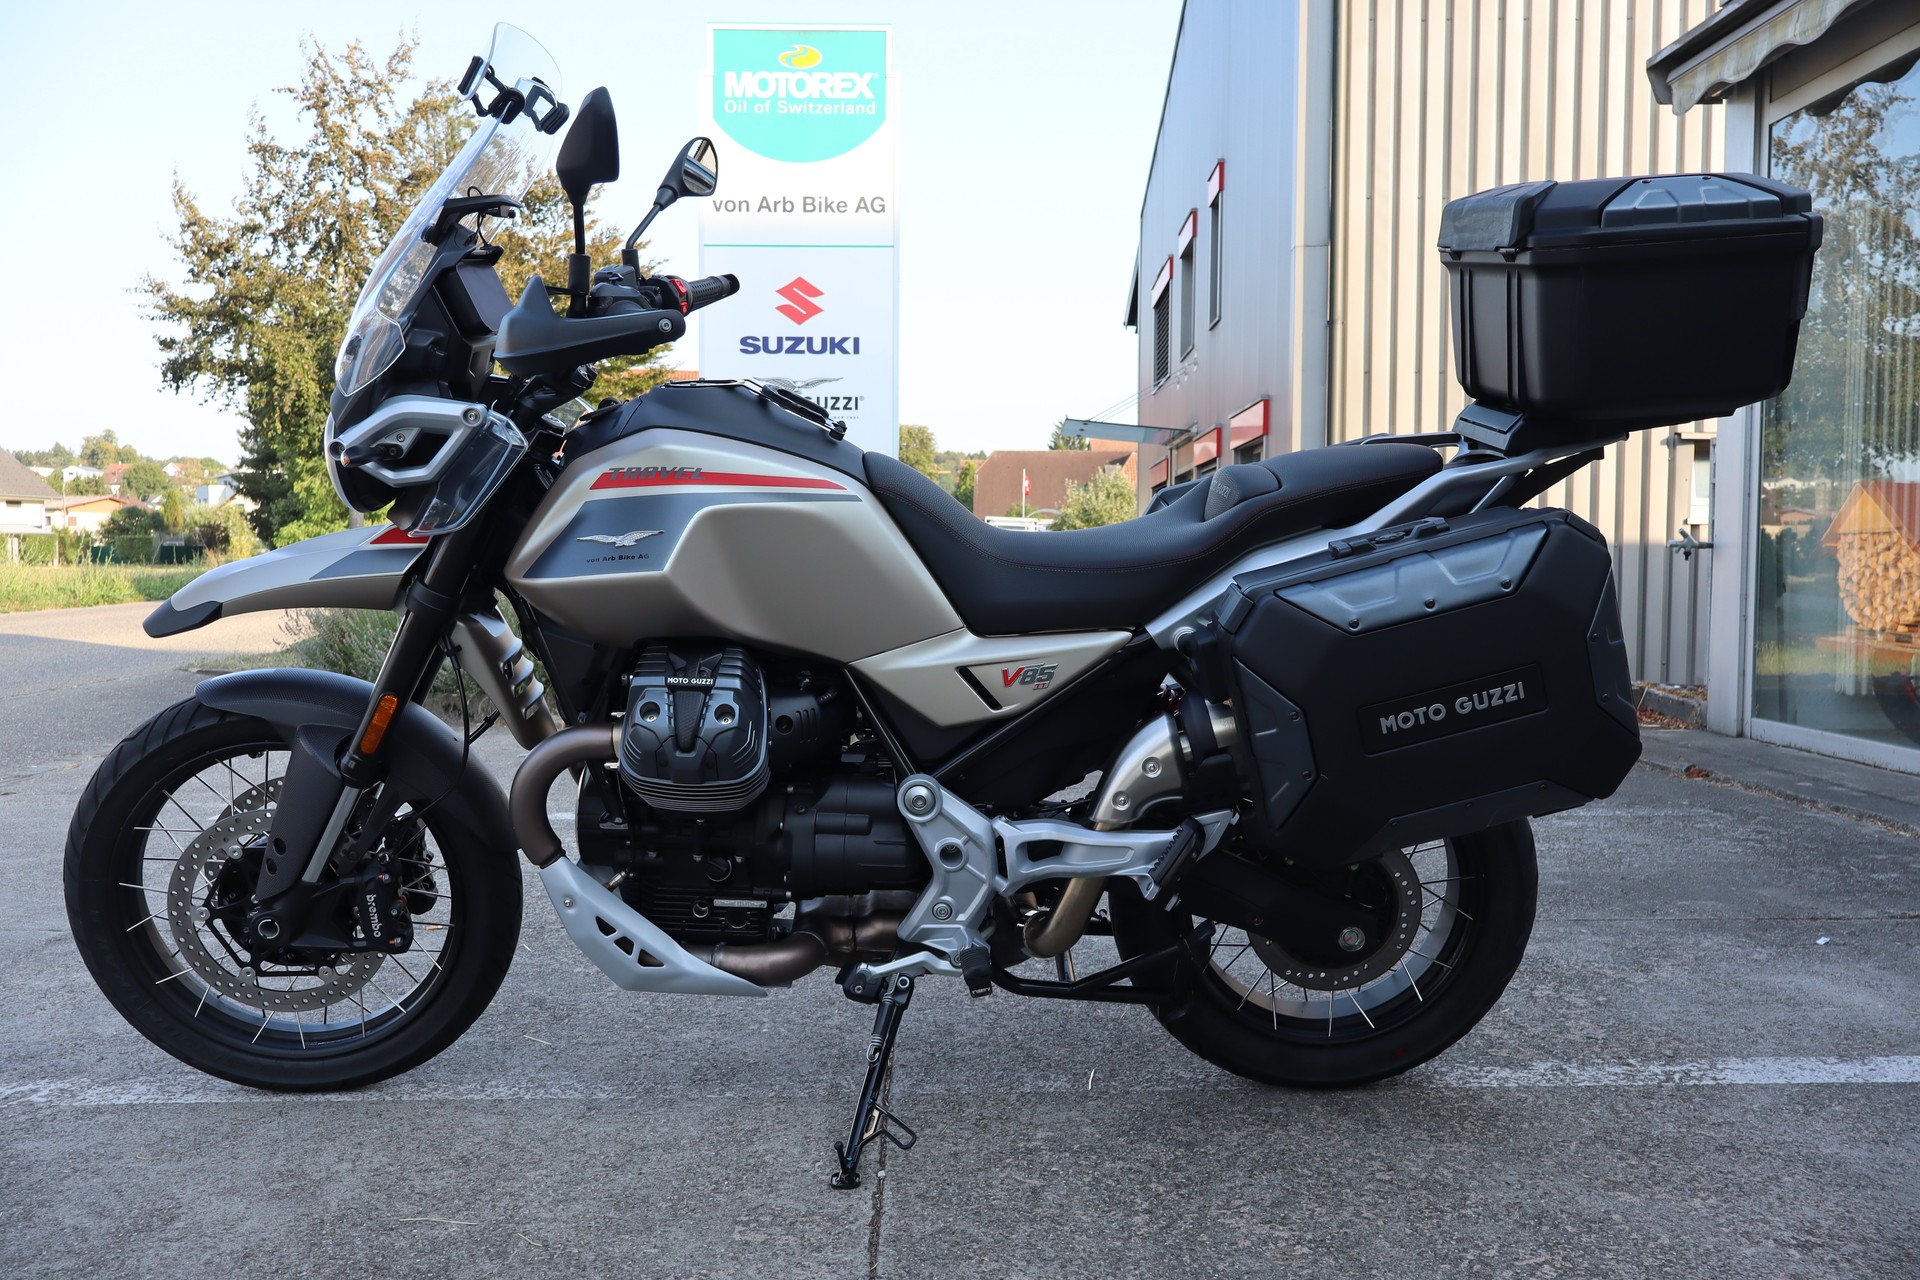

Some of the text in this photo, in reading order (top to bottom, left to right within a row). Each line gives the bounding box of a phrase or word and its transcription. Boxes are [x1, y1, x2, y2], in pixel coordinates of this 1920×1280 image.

[724, 71, 875, 98] MOTOREX
[724, 100, 876, 115] Oil of Switzerland
[712, 196, 886, 213] von Arb Bike AG
[739, 336, 860, 355] SUZUKI
[804, 396, 859, 411] UZZI
[608, 466, 706, 481] TRAVEL
[602, 554, 616, 562] Arb
[618, 553, 636, 561] Bike
[1001, 662, 1059, 688] V85
[1379, 681, 1525, 734] MOTO GUZZI
[366, 894, 382, 938] brembo
